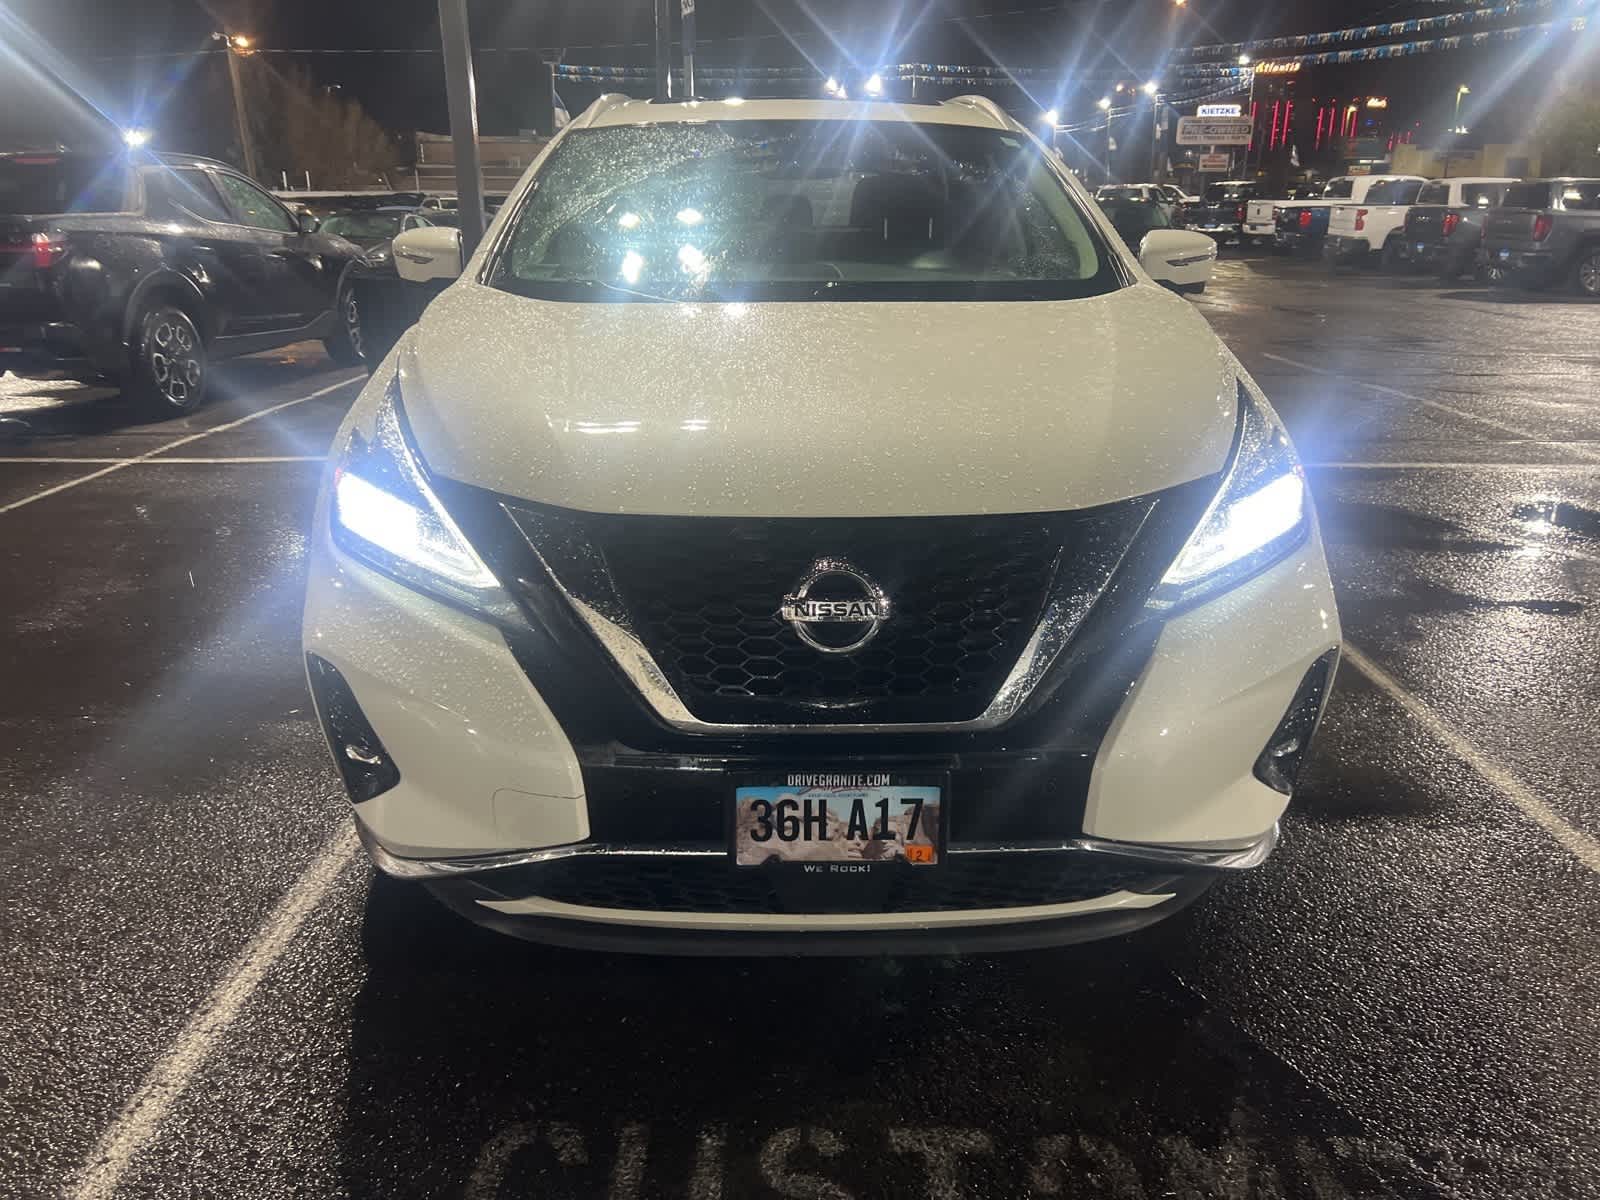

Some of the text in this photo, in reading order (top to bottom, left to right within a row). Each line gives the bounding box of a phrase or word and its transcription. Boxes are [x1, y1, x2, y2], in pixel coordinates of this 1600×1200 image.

[1255, 61, 1300, 73] Atlantis
[1200, 107, 1237, 115] KIETZKE
[794, 603, 880, 617] NISSAN
[787, 774, 890, 786] DRIVEGRANITE.COM
[750, 798, 924, 842] 36H A17
